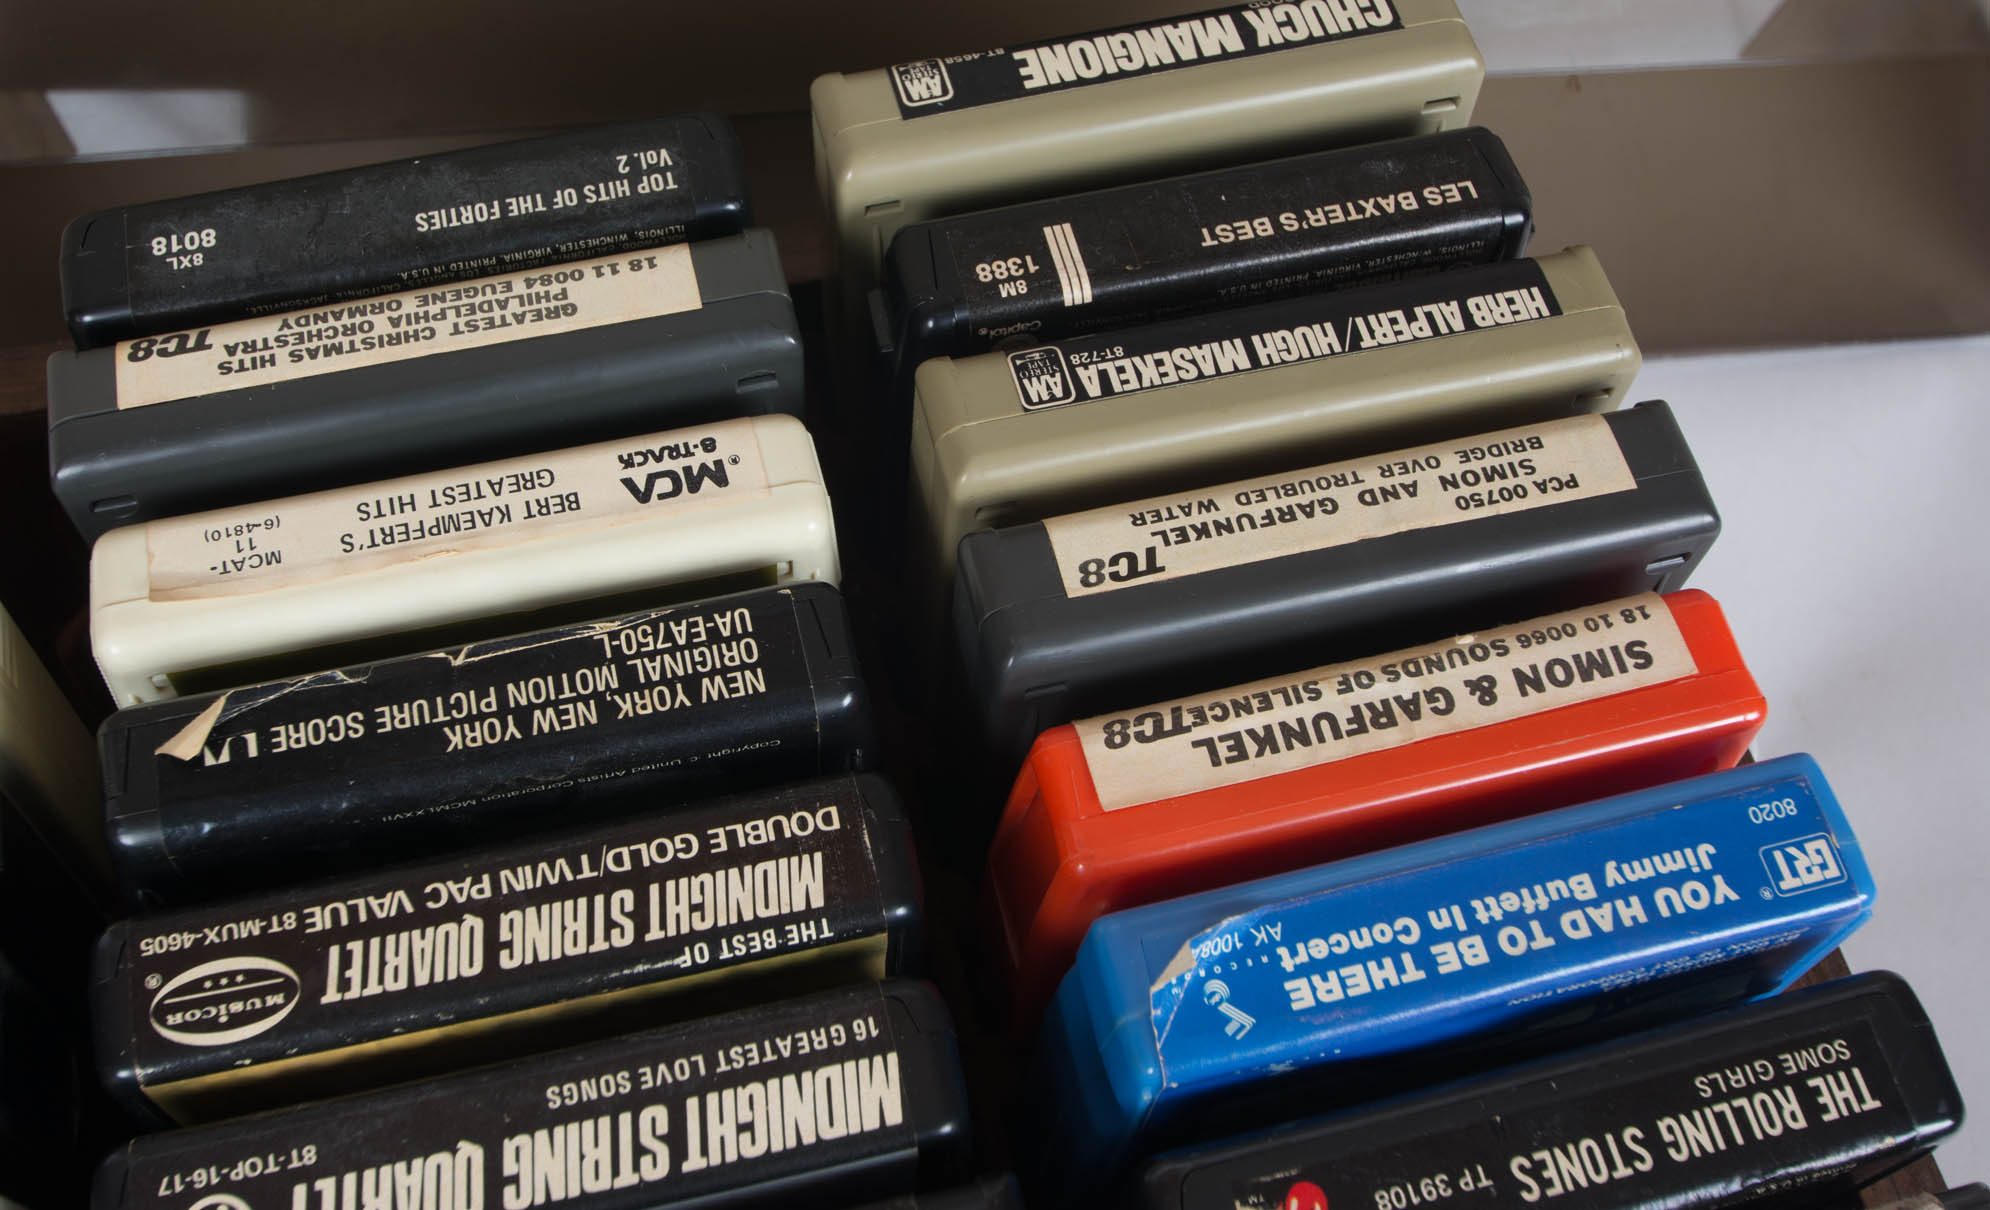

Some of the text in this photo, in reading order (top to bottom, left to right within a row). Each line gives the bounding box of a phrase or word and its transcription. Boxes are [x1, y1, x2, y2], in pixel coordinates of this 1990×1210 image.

[1012, 0, 1393, 89] CHUCK MANGIONE
[616, 148, 672, 174] Vol. 2
[414, 171, 678, 232] TOP HITS OF THE FORTIES
[1200, 180, 1478, 246] LES BAXTER'S BEST
[150, 228, 217, 256] 8018
[166, 252, 203, 270] 8XL
[448, 256, 496, 272] PRINTED
[397, 267, 428, 280] U.S.A.
[432, 264, 445, 275] IN
[975, 254, 1040, 283] 1388
[998, 279, 1028, 298] 8M
[278, 256, 658, 332] 18 11 0084 EUGENE ORMANDY
[1466, 286, 1550, 328] HERB
[216, 302, 578, 376] GREATEST CHRISTMAS HITS
[222, 286, 568, 358] PHILADELPHIA ORCHESTRA
[988, 320, 1042, 338] Capitol
[1252, 298, 1465, 366] ALPERT/HUGH
[126, 328, 214, 363] TC8
[1026, 358, 1050, 370] TAPE
[1070, 344, 1124, 365] 8T-728
[1074, 338, 1252, 398] MASEKELA
[1018, 364, 1060, 378] STEREO
[618, 437, 717, 470] 8-TRACK
[356, 468, 555, 522] GREATEST HITS
[619, 459, 729, 504] MCA
[1128, 434, 1544, 527] BRIDGE OVER TROUBLED WATER
[1150, 458, 1536, 547] SIMON AND GARFUNKEL
[1454, 472, 1580, 511] PCA 00750
[204, 514, 281, 542] (6-4810)
[235, 536, 258, 554] 11
[340, 492, 581, 554] BERT KAEMPFERT'S
[210, 550, 282, 576] MCAT-
[1078, 546, 1166, 588] TC8
[592, 606, 753, 659] UA-EA750-L
[1186, 604, 1652, 727] 18 10 0066 SOUNDS OF SILENCE
[270, 636, 759, 753] ORIGINAL MOTION PICTURE SCORE
[442, 666, 766, 752] NEW YORK, NEW YORK
[1190, 640, 1654, 768] SIMON & GARFUNKEL
[706, 738, 782, 760] Copyright
[1102, 704, 1192, 750] TC8
[577, 769, 626, 784] Artists
[631, 758, 682, 774] United
[481, 779, 574, 803] Corporation
[1748, 796, 1798, 824] 8020
[302, 805, 840, 934] DOUBLE GOLD/TWIN PAC VALUE
[1770, 838, 1842, 890] GRT
[1274, 842, 1717, 973] Jimmy Buffett In Concert
[1560, 894, 1648, 940] HAD
[1652, 872, 1740, 918] YOU
[139, 911, 297, 957] 8T-MUX-4605
[319, 851, 825, 1004] MIDNIGHT STRING QUARTET
[678, 918, 834, 968] THE BEST OF
[1252, 920, 1284, 947] AK
[1496, 920, 1556, 957] TO
[1430, 933, 1490, 974] BE
[1283, 950, 1426, 1012] THERE
[545, 1016, 880, 1110] 16 GREATEST LOVE SONGS
[1692, 1038, 1852, 1098] SOME GIRLS
[681, 1051, 903, 1174] MIDNIGHT
[1508, 1066, 1882, 1202] THE ROLLING STONES
[158, 1144, 317, 1196] 8T-TOP-16-17
[503, 1104, 670, 1210] STRING
[1374, 1162, 1494, 1210] TP 39108
